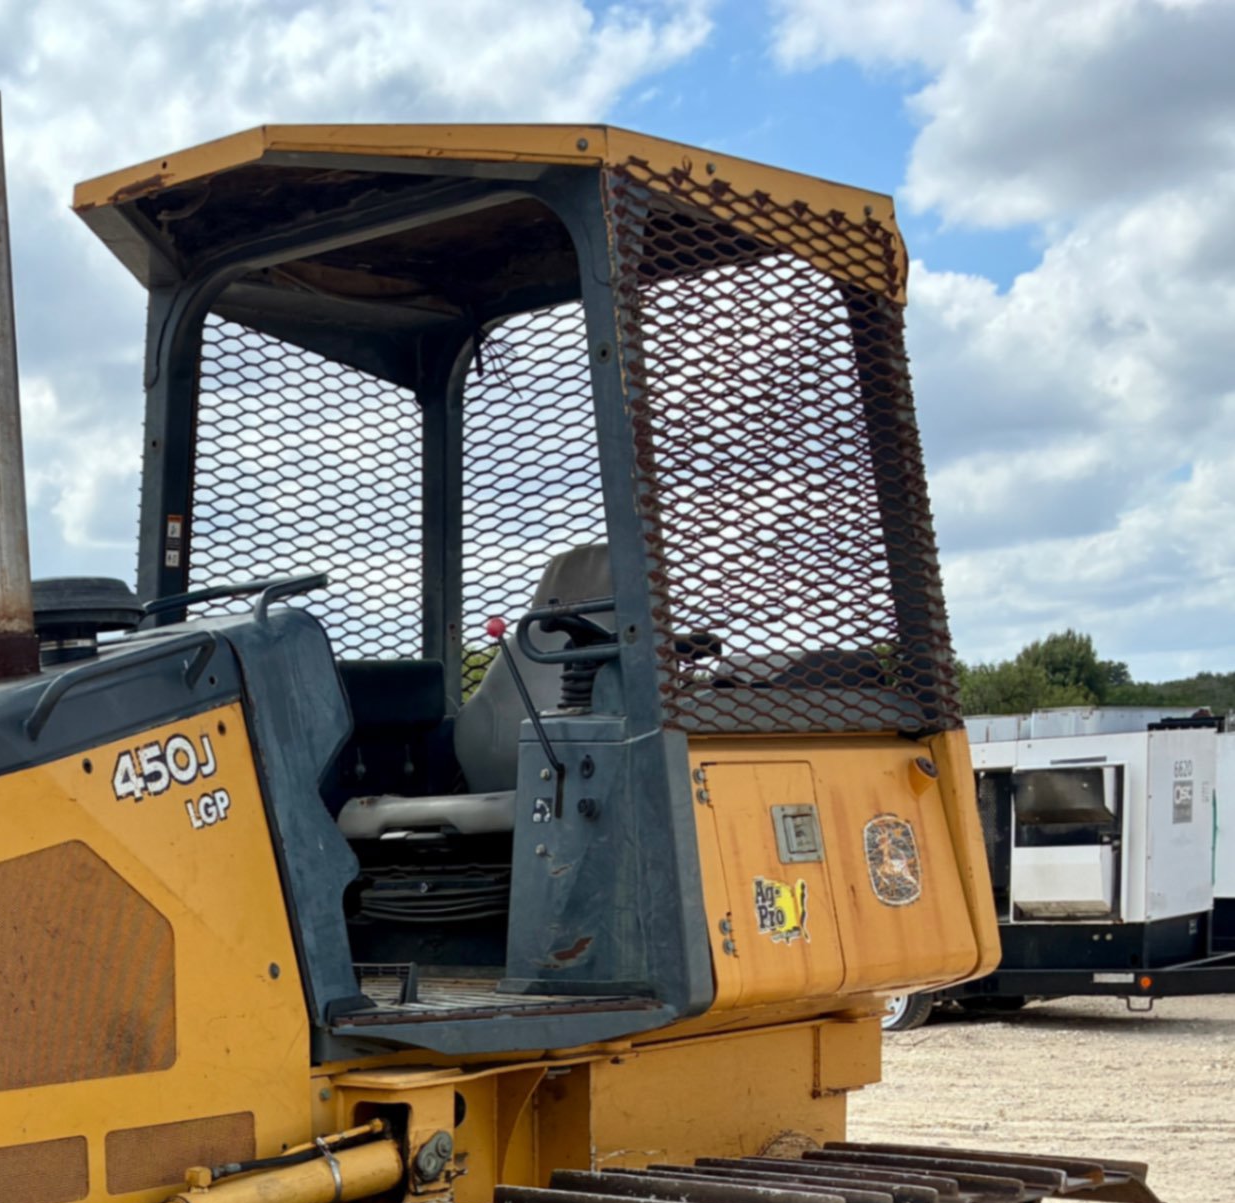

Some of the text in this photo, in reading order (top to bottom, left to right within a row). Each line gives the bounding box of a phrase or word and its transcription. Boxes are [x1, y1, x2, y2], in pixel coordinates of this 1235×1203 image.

[111, 733, 217, 803] 450J
[185, 788, 231, 829] LGP
[757, 905, 785, 928] Pro
